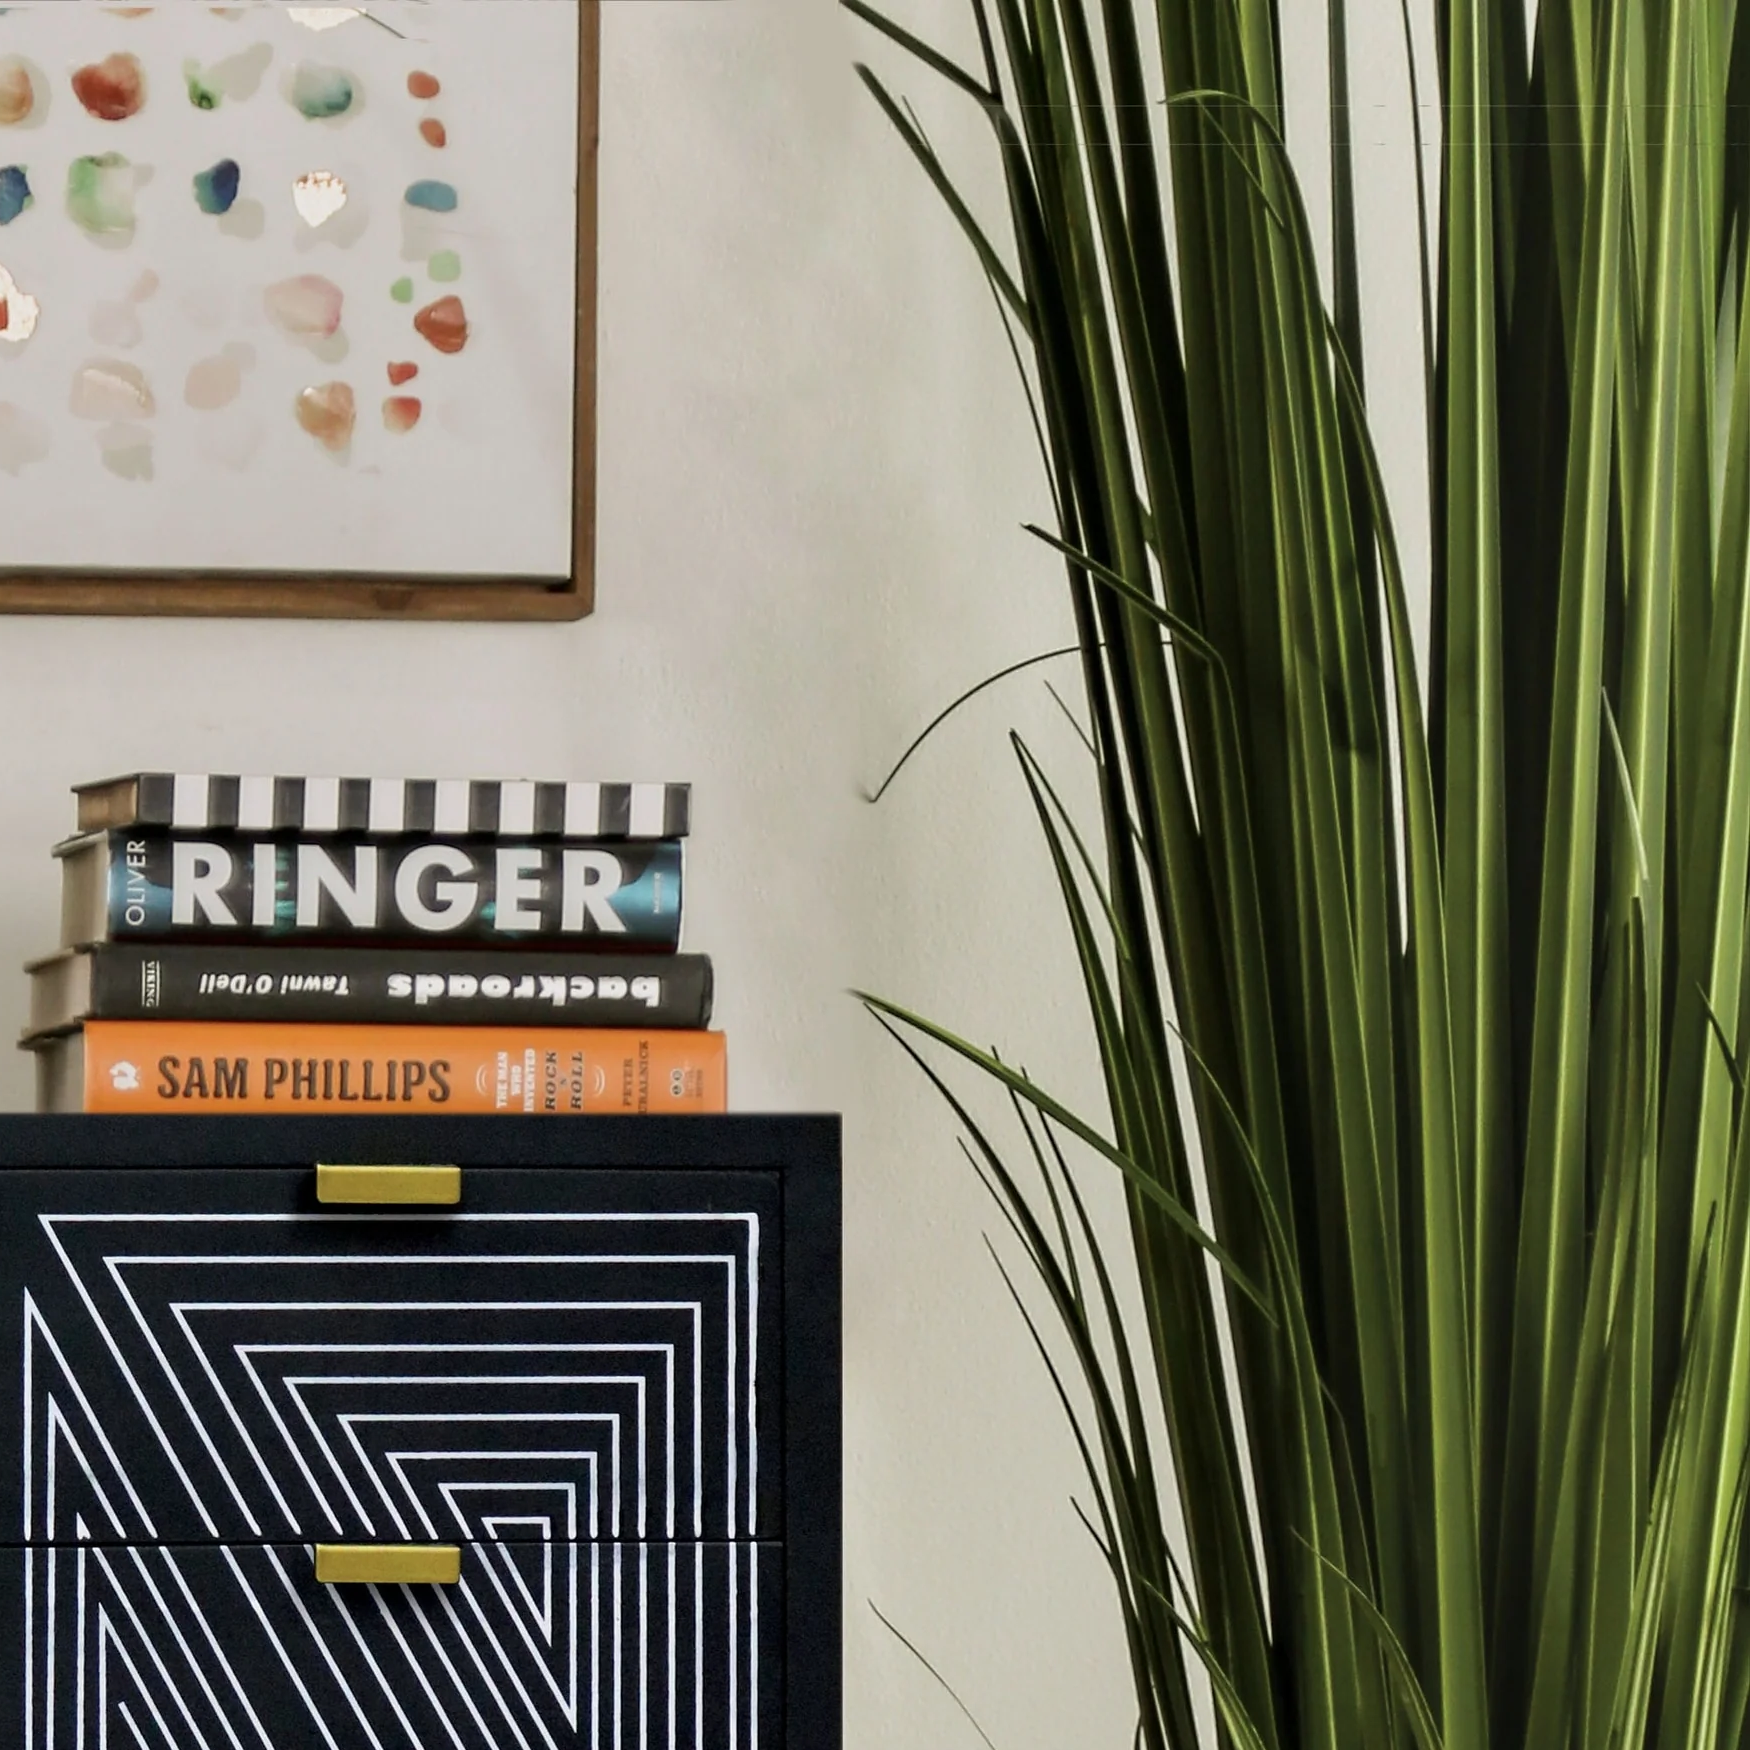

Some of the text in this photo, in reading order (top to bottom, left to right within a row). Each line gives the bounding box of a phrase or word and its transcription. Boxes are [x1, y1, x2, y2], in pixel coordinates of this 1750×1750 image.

[125, 840, 146, 926] OLIVER
[171, 841, 627, 932] RINGER
[145, 960, 157, 1008] VIKING
[199, 973, 350, 996] Tawni O'Dell
[387, 973, 661, 1008] backroads
[157, 1055, 452, 1103] SAM PHILLIPS
[496, 1051, 509, 1109] THE MAN
[511, 1064, 522, 1096] WHO
[523, 1047, 536, 1112] INVENTED
[545, 1051, 557, 1110] ROCK
[571, 1051, 583, 1110] ROLL
[622, 1057, 633, 1106] PETER
[637, 1039, 649, 1114] URALNICK
